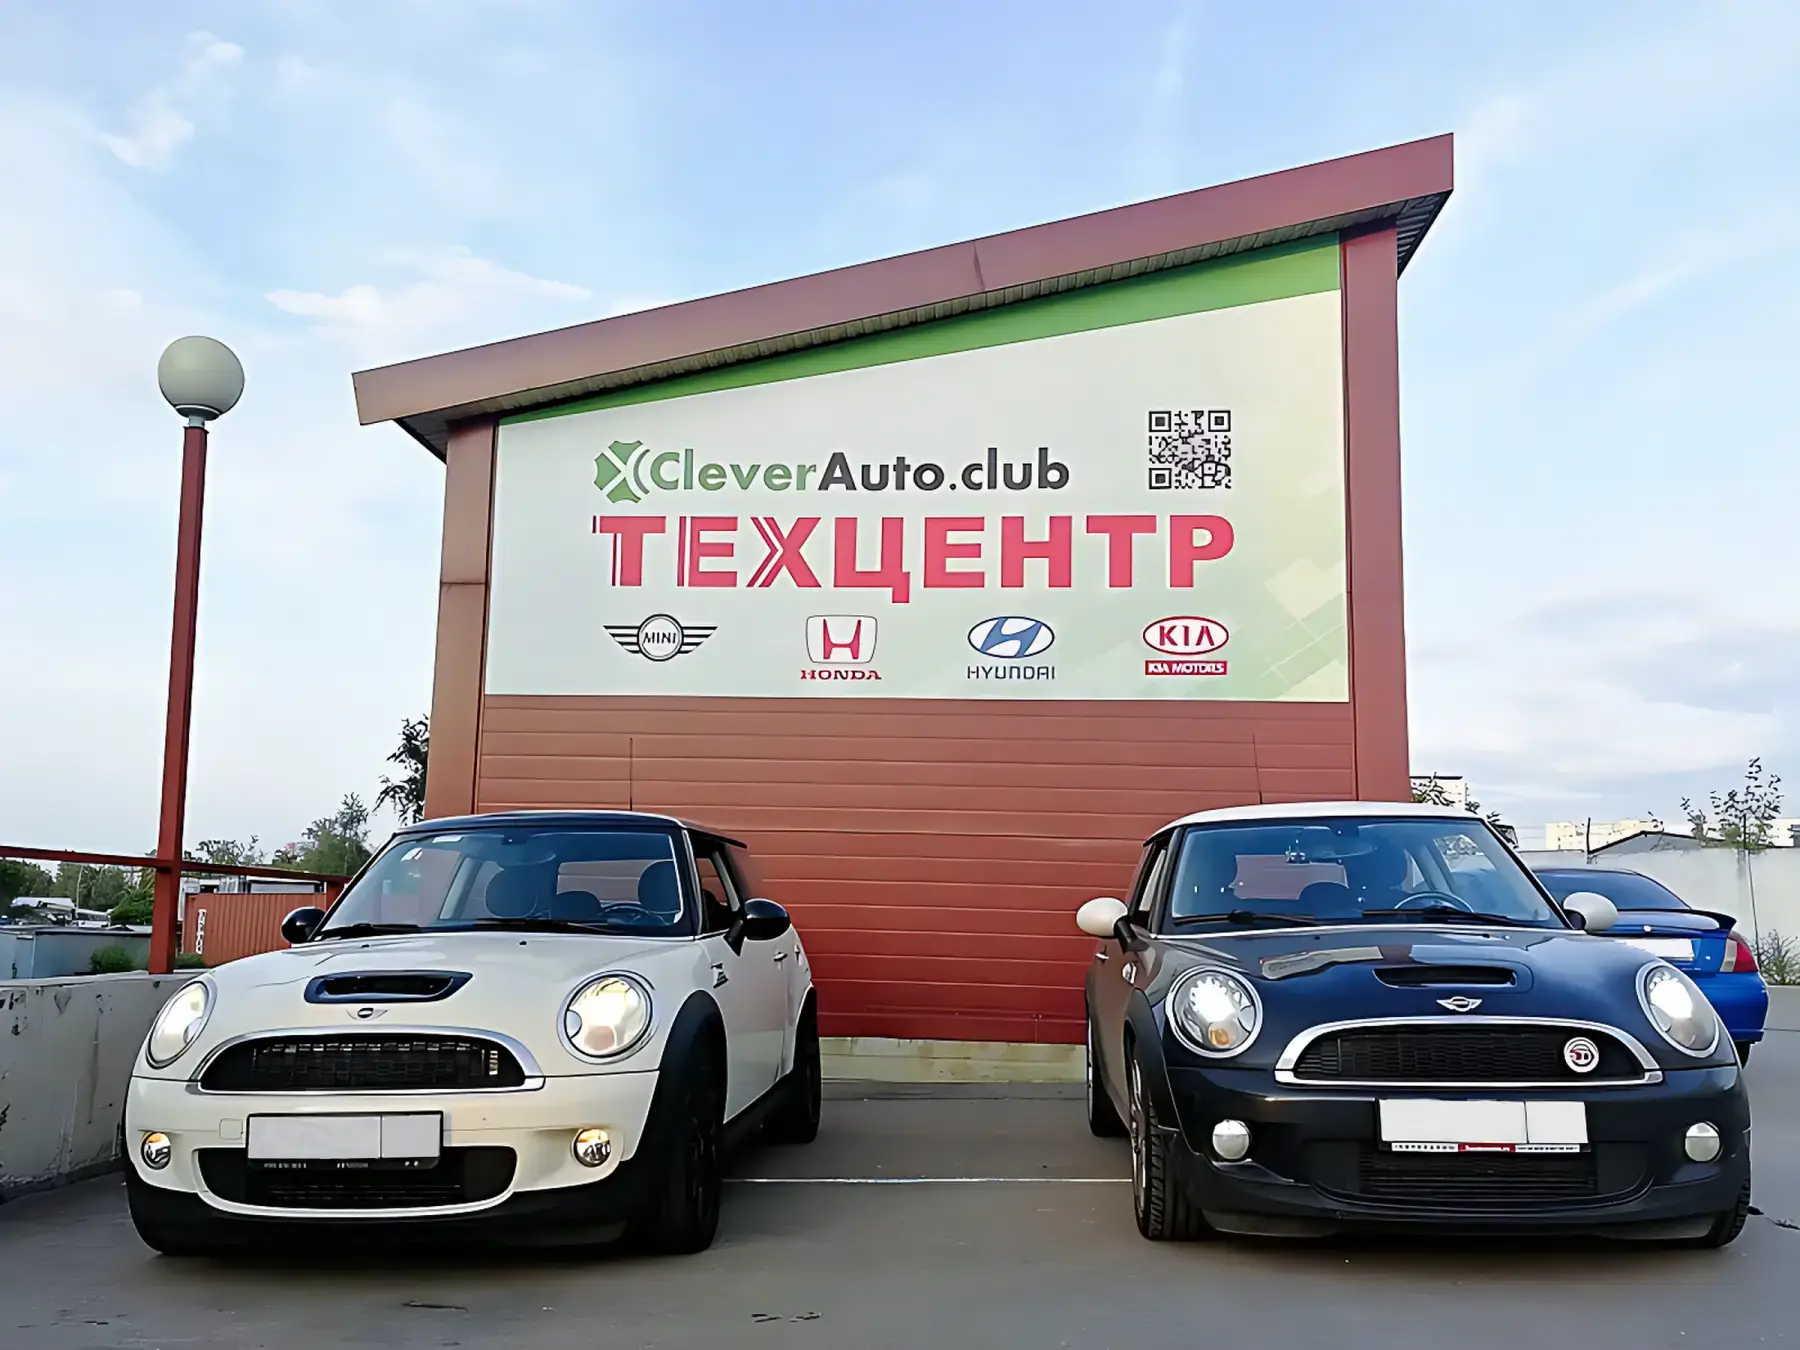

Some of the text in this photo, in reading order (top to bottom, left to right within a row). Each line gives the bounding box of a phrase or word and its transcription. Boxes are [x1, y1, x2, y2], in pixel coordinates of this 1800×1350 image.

[649, 447, 1070, 491] CleverAuto.club
[592, 514, 1235, 604] ТЕХЦЕНТР
[643, 631, 677, 645] MINI
[1159, 624, 1215, 647] KIA
[800, 669, 882, 681] HONDA
[967, 665, 1055, 680] HYUNDAI
